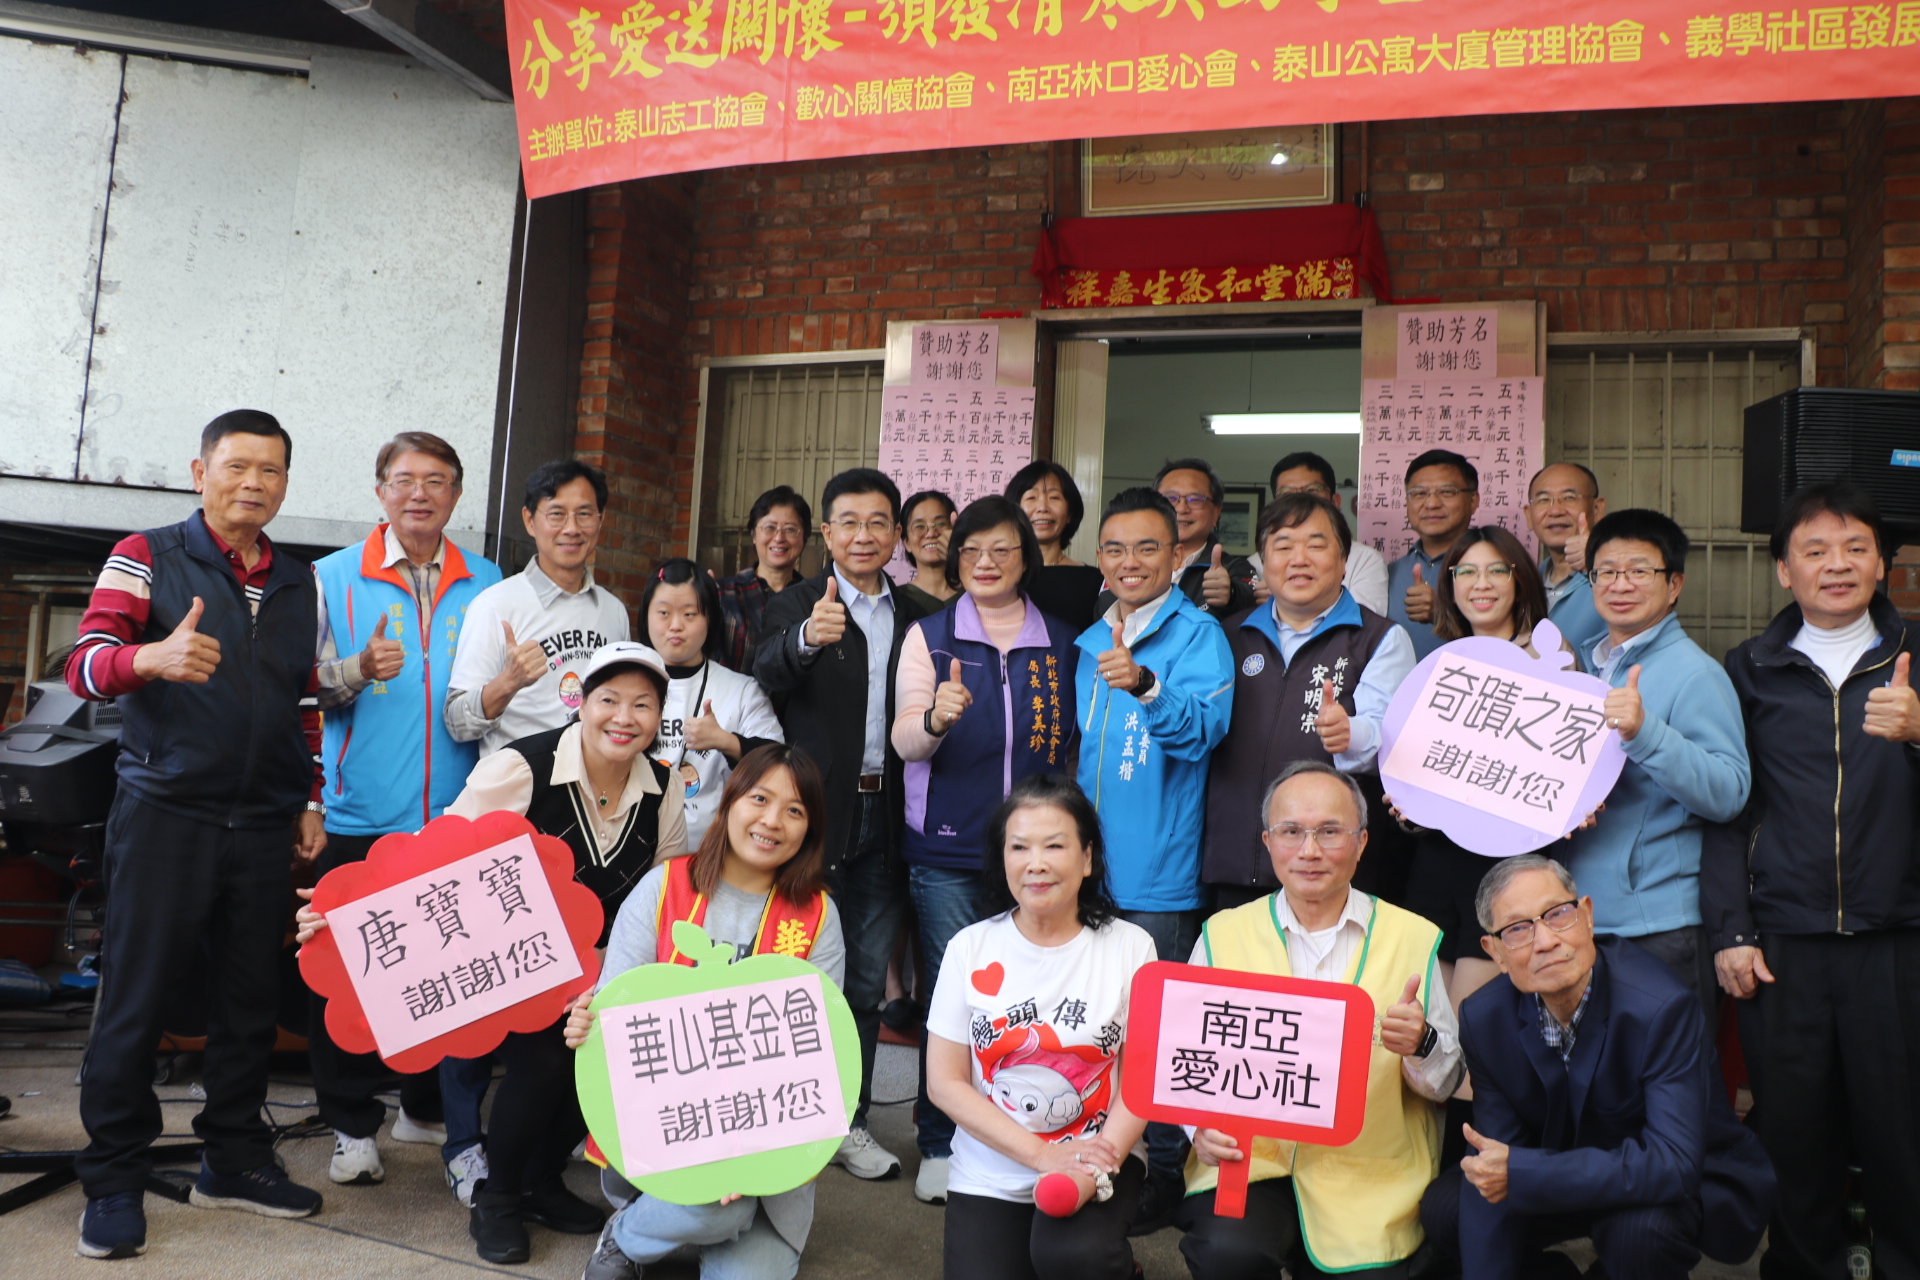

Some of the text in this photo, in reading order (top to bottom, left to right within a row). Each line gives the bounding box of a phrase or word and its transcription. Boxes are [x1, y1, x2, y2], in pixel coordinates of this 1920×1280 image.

[926, 361, 984, 381] 謝謝您
[1415, 349, 1483, 372] 謝謝您
[1428, 666, 1606, 765] 奇蹟之家
[1422, 739, 1565, 812] 謝謝您
[357, 855, 532, 978] 唐寶寶
[401, 931, 558, 1021] 謝謝您
[625, 987, 823, 1084] 華山基金會
[1201, 1000, 1303, 1055] 南亞
[658, 1078, 826, 1146] 謝謝您
[1170, 1047, 1321, 1110] 愛心社
